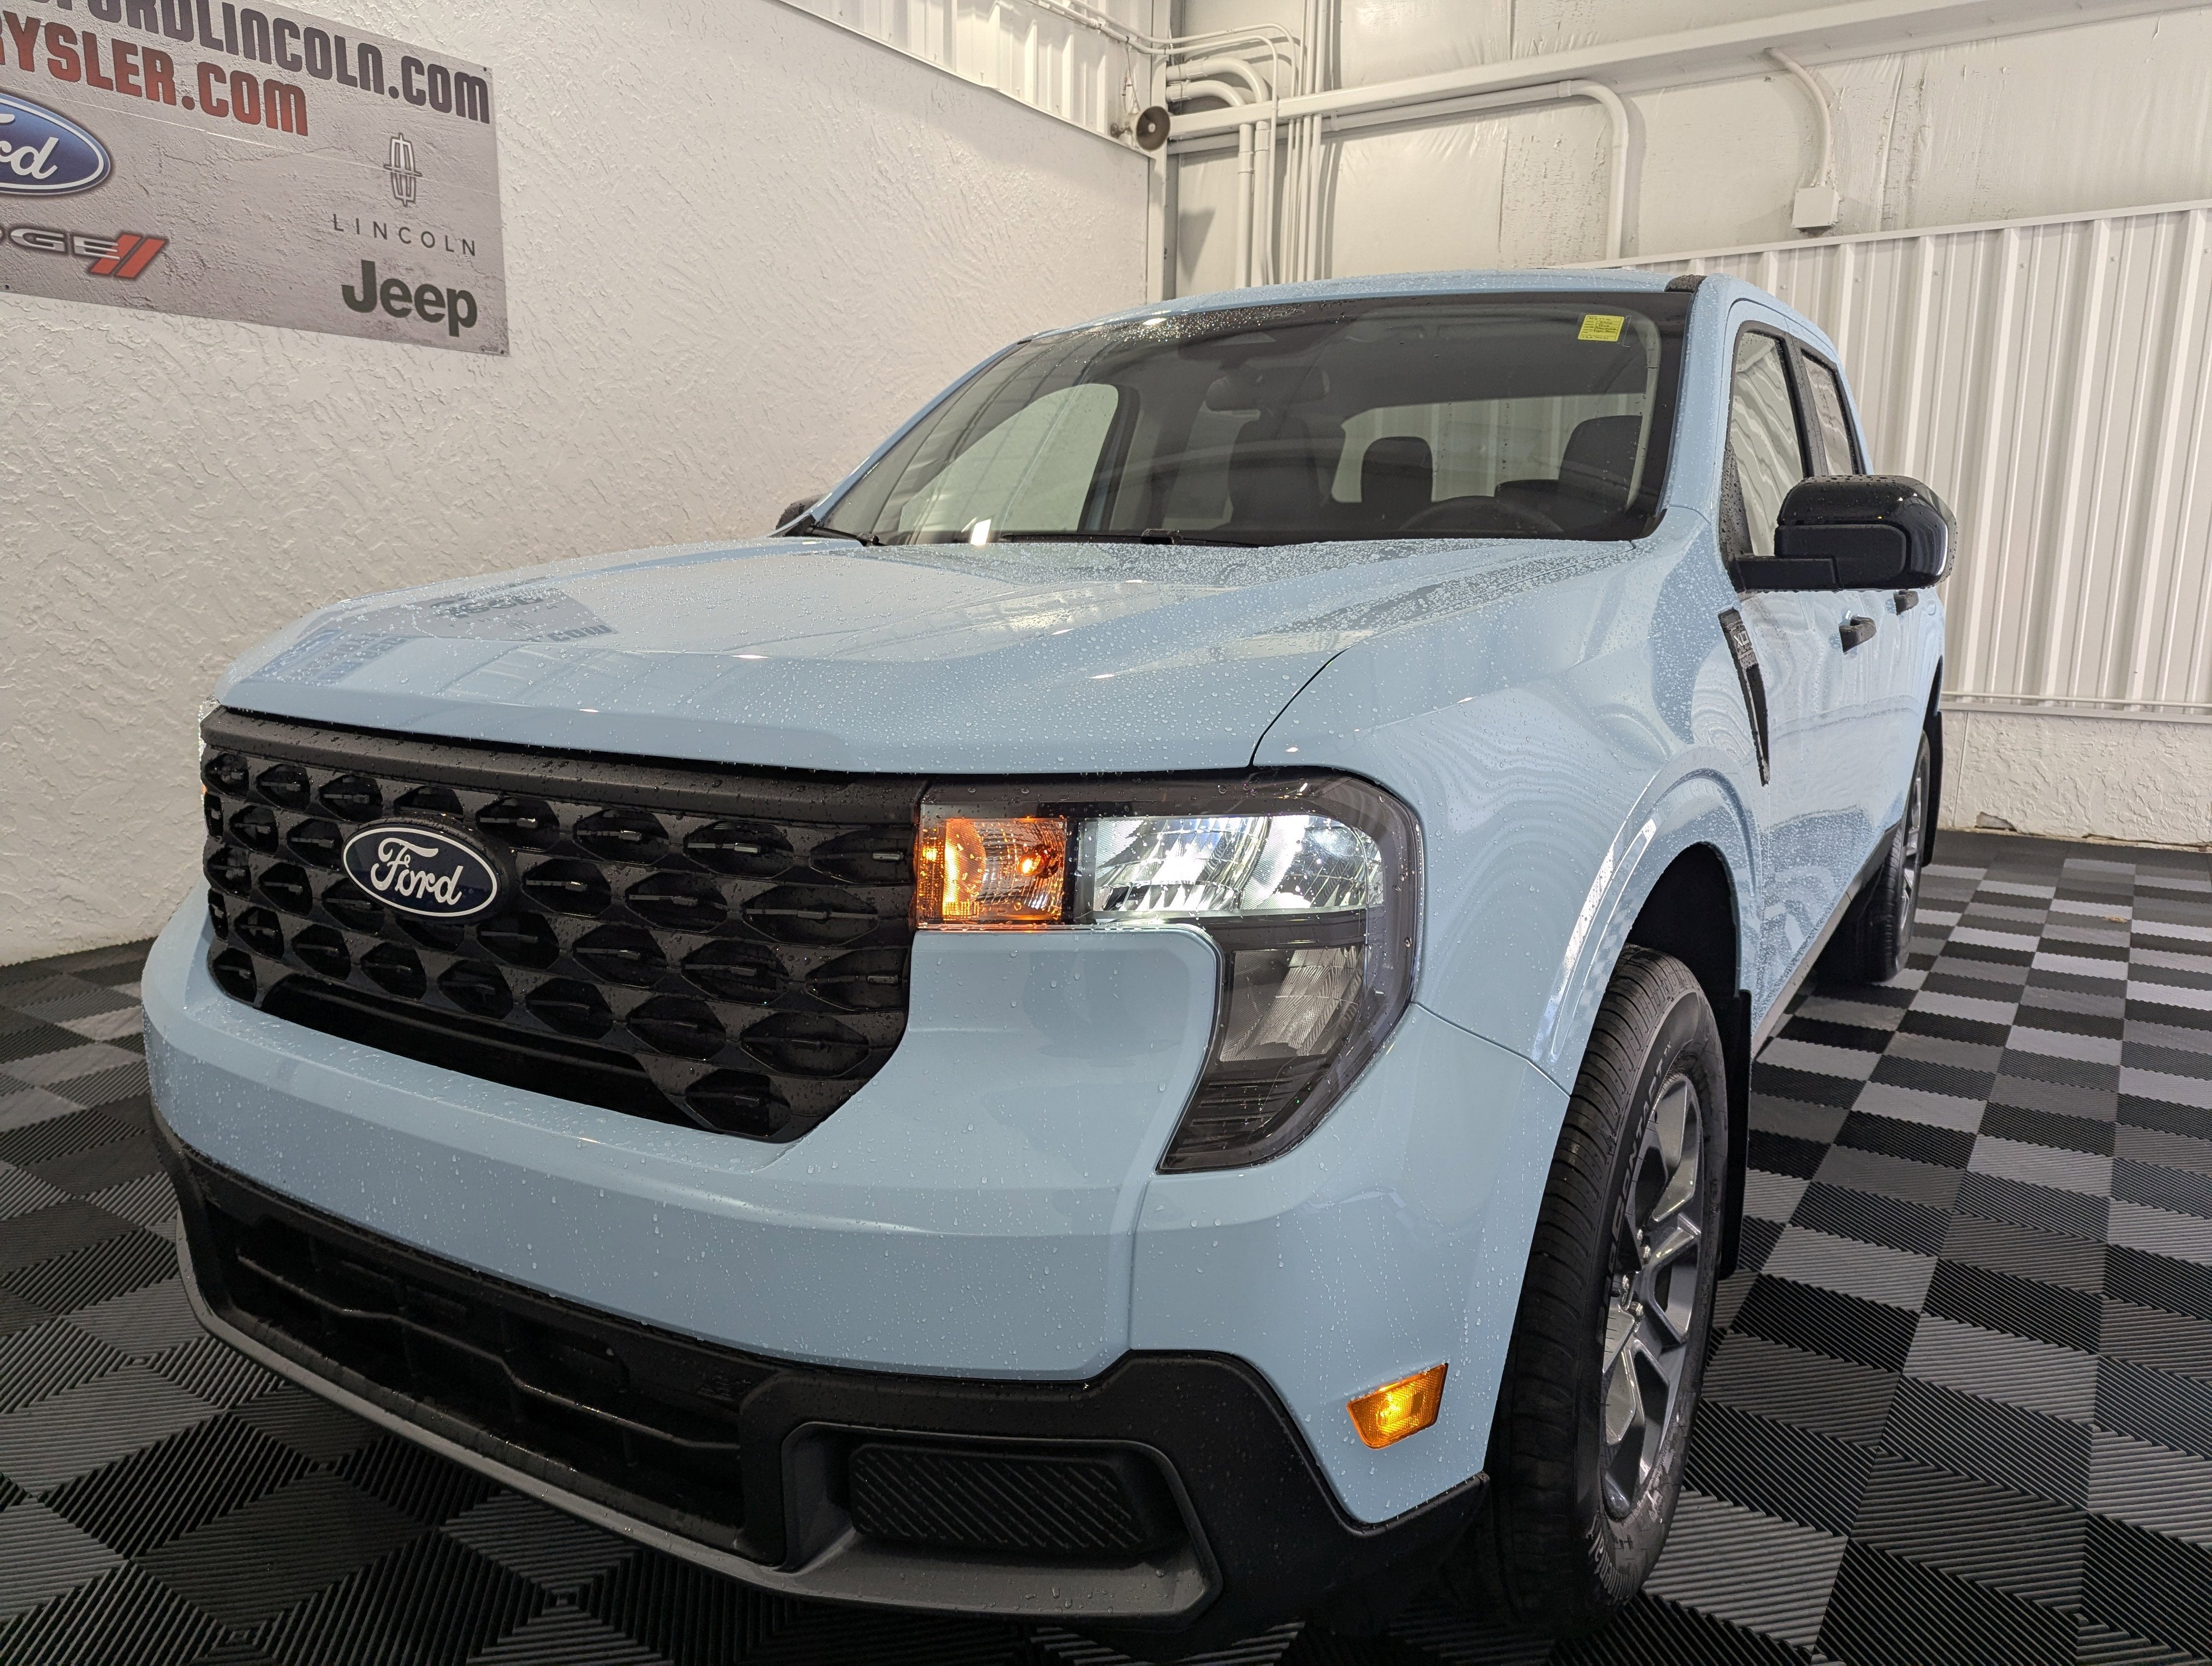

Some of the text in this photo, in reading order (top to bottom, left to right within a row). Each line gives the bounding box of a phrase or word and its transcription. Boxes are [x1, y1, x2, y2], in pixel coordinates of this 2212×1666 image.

[0, 10, 308, 137] YSLER.COM
[0, 228, 121, 260] GE
[332, 213, 476, 257] LINCOLN
[341, 259, 478, 338] Jeep
[370, 837, 464, 906] Ford
